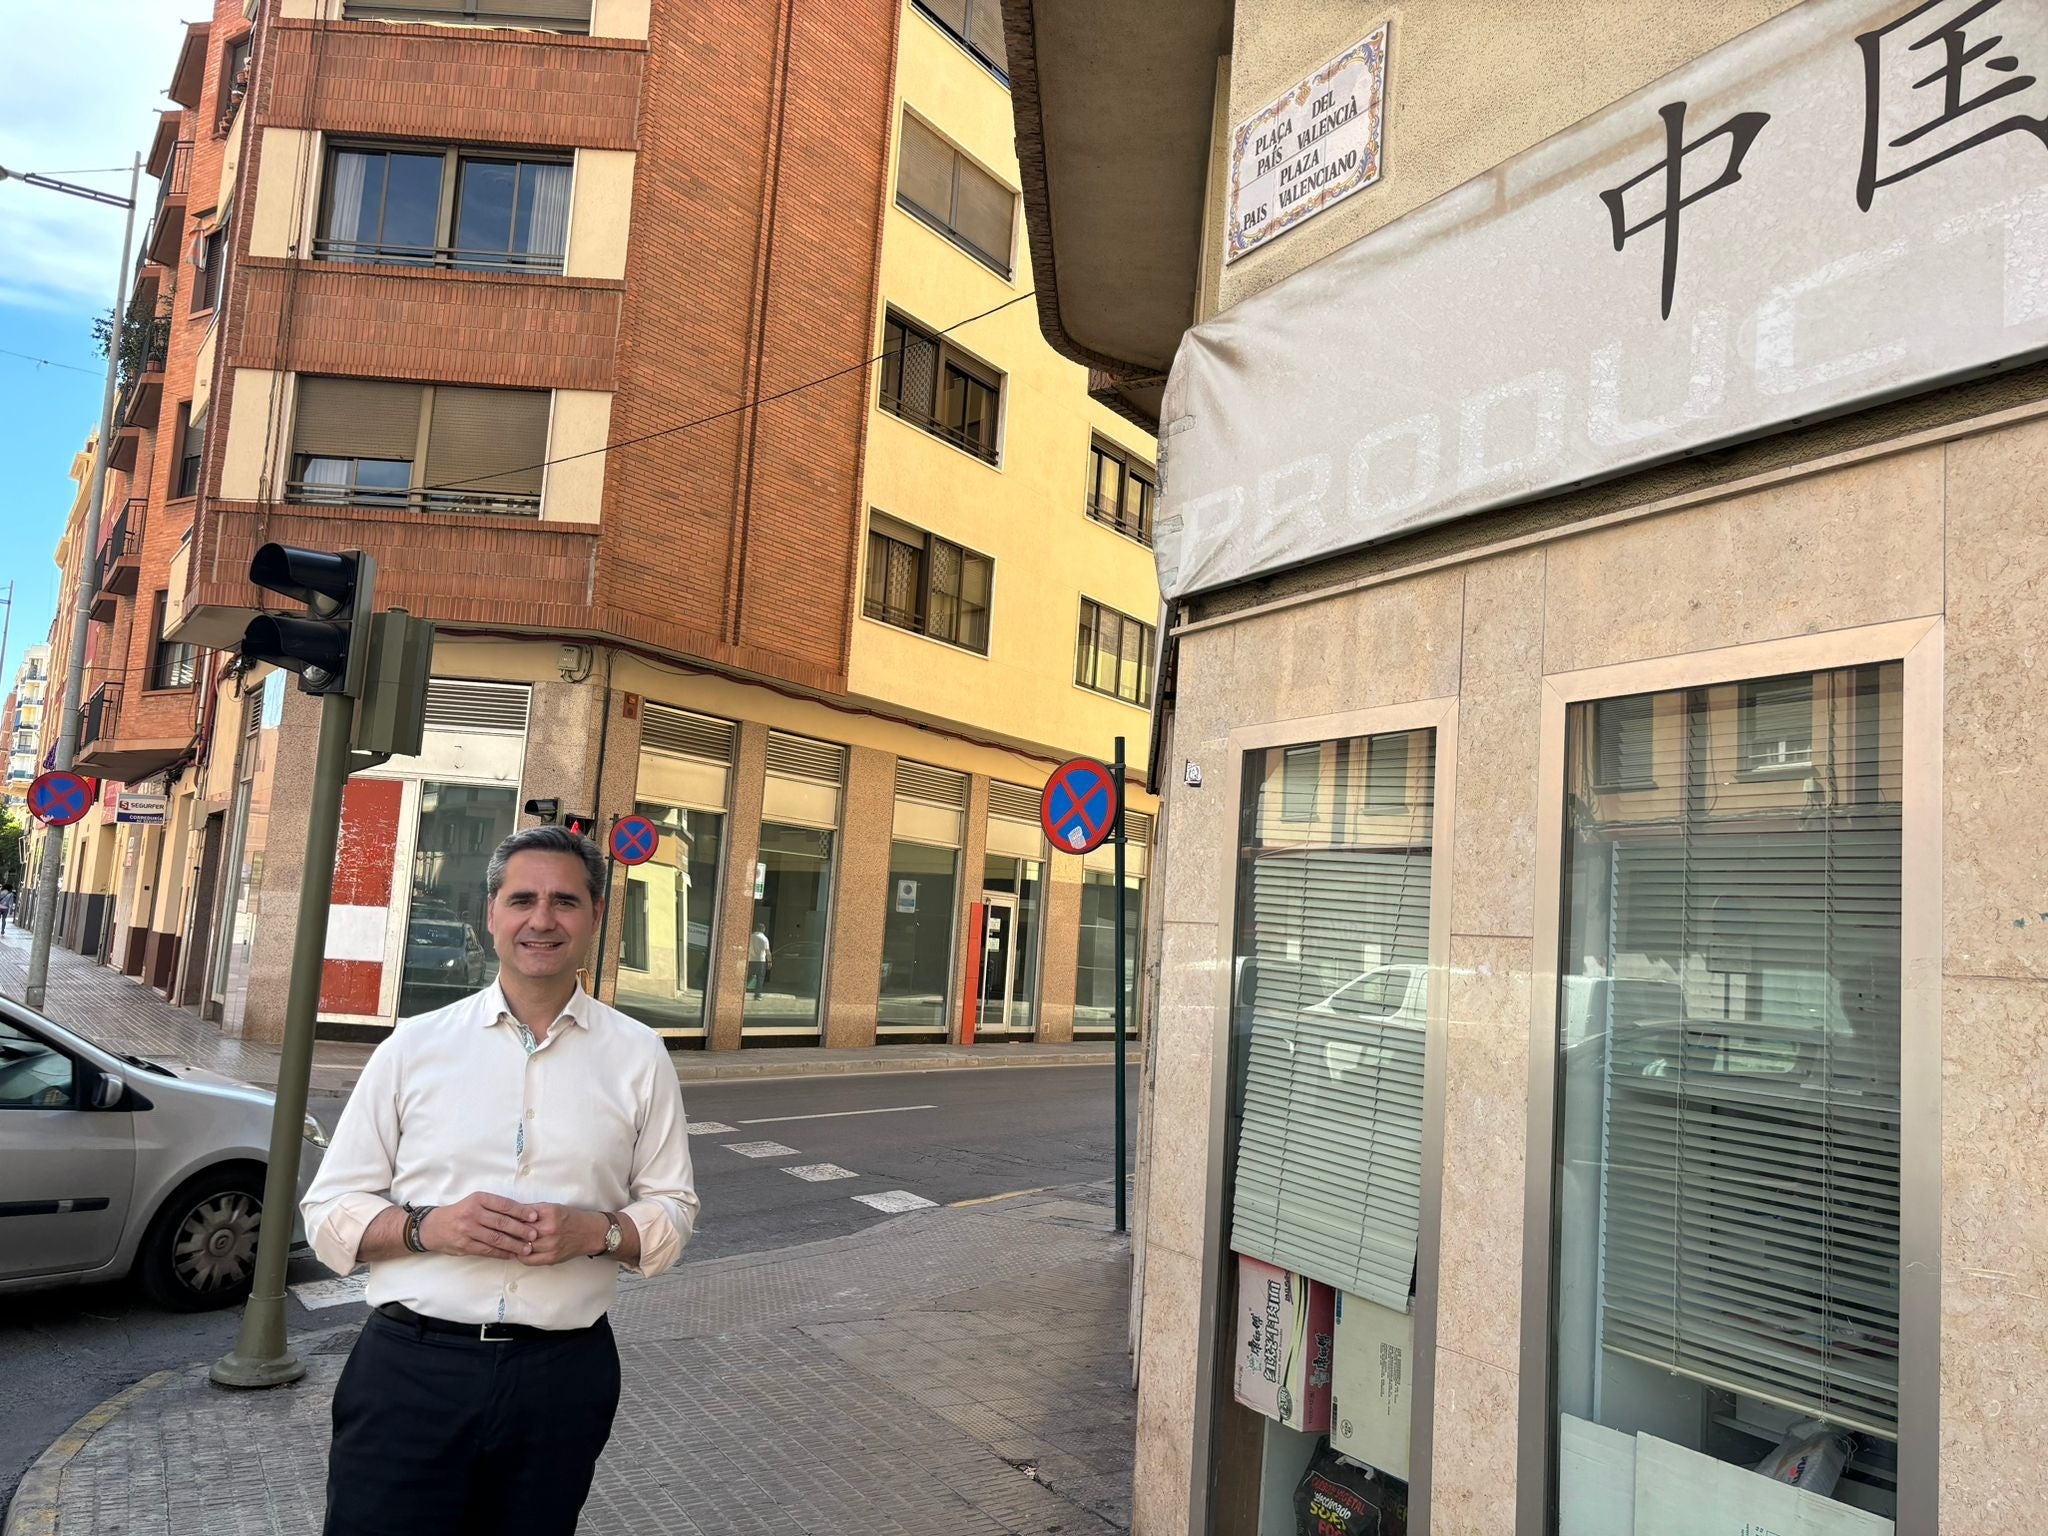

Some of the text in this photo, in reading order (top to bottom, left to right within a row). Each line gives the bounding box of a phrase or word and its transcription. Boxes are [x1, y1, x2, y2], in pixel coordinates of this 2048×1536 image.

[1255, 90, 1336, 156] PLAÇA DEL
[1257, 95, 1358, 177] PAÍS VALENCIÀ
[1600, 0, 2048, 319] 中国
[1244, 150, 1357, 231] PAIS VALENCIANO
[1280, 149, 1320, 187] PLAZA
